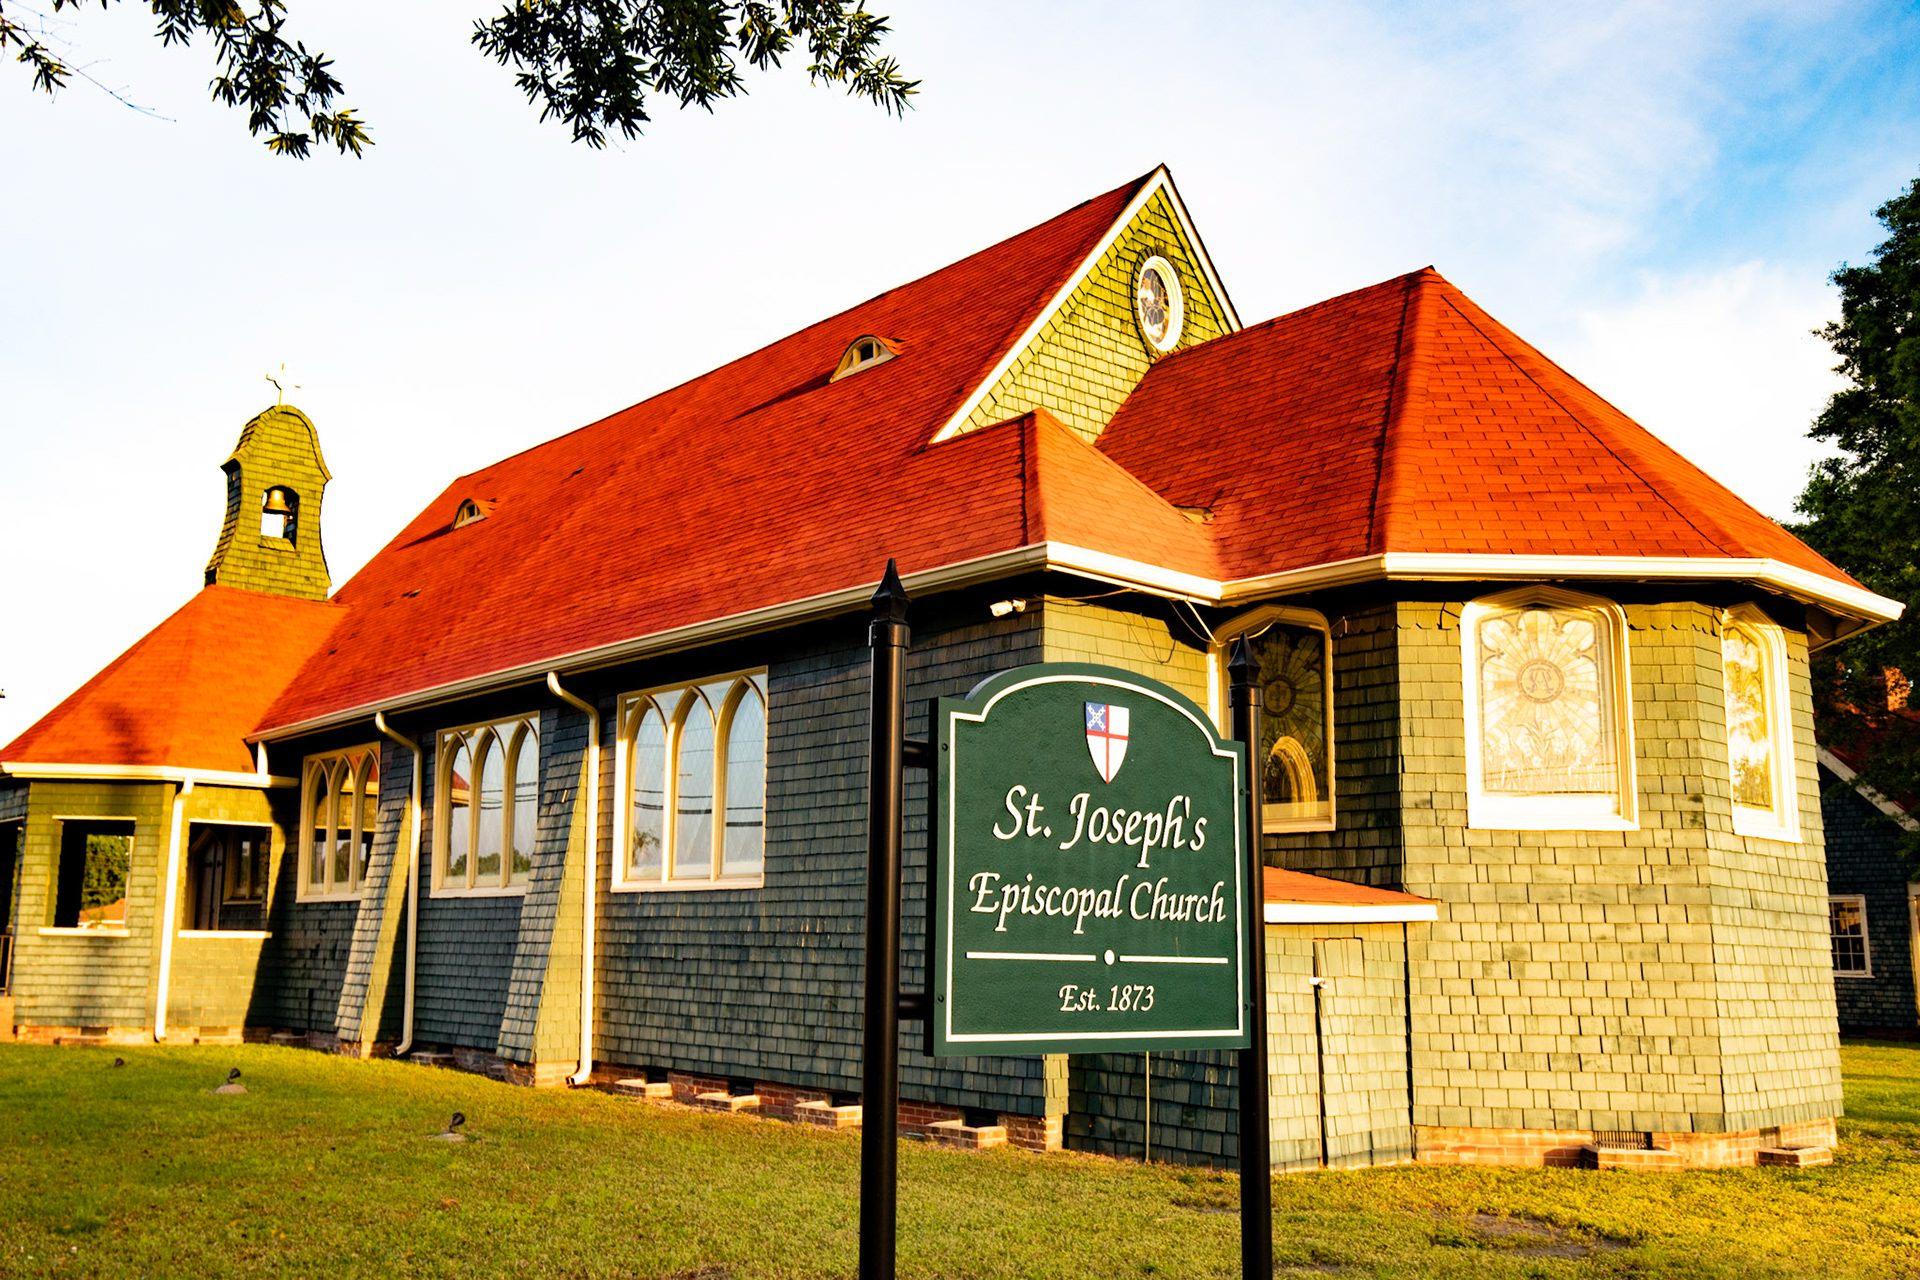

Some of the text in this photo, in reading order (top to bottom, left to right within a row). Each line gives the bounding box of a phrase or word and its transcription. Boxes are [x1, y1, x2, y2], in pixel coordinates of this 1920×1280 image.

[992, 784, 1208, 868] St. Joseph's
[968, 871, 1227, 934] Episcopal Church
[1058, 984, 1155, 1012] Est. 1873
